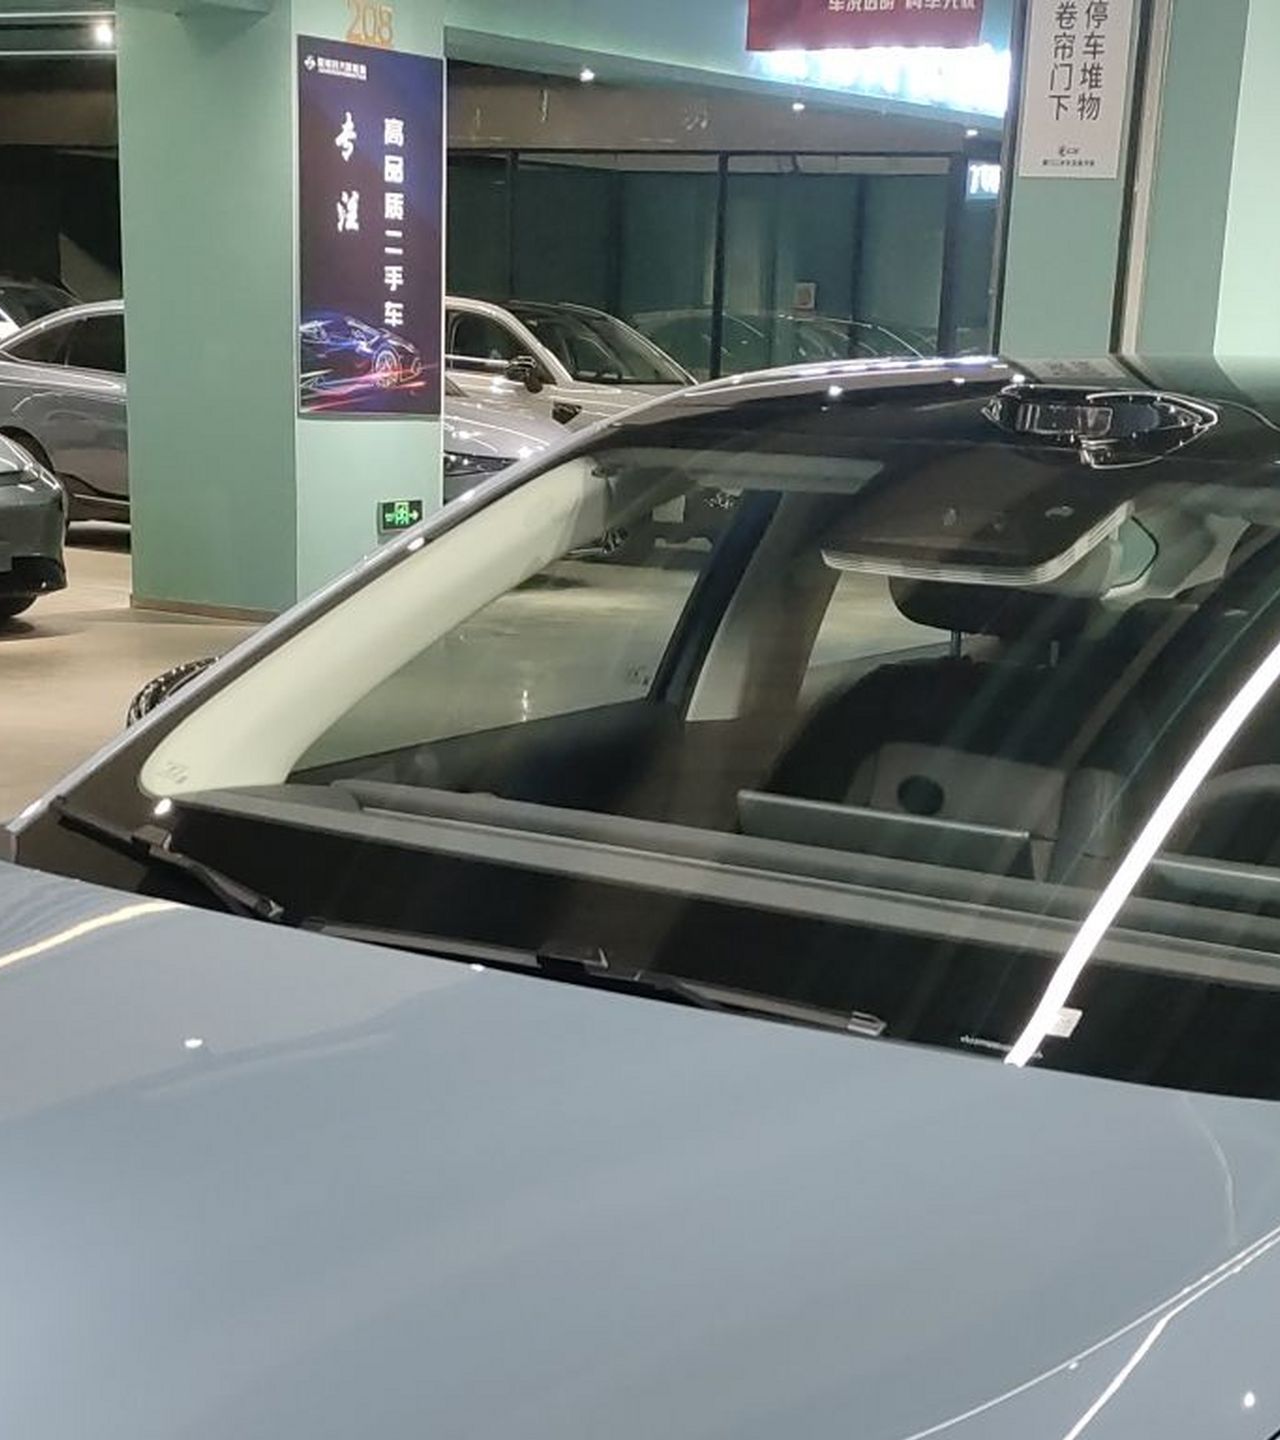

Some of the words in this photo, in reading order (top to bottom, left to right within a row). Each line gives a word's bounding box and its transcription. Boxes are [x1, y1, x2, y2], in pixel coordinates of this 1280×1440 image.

[1049, 1, 1078, 121] 卷帘门下
[1077, 0, 1109, 121] 停车堆物
[384, 118, 405, 327] 高品质二手车
